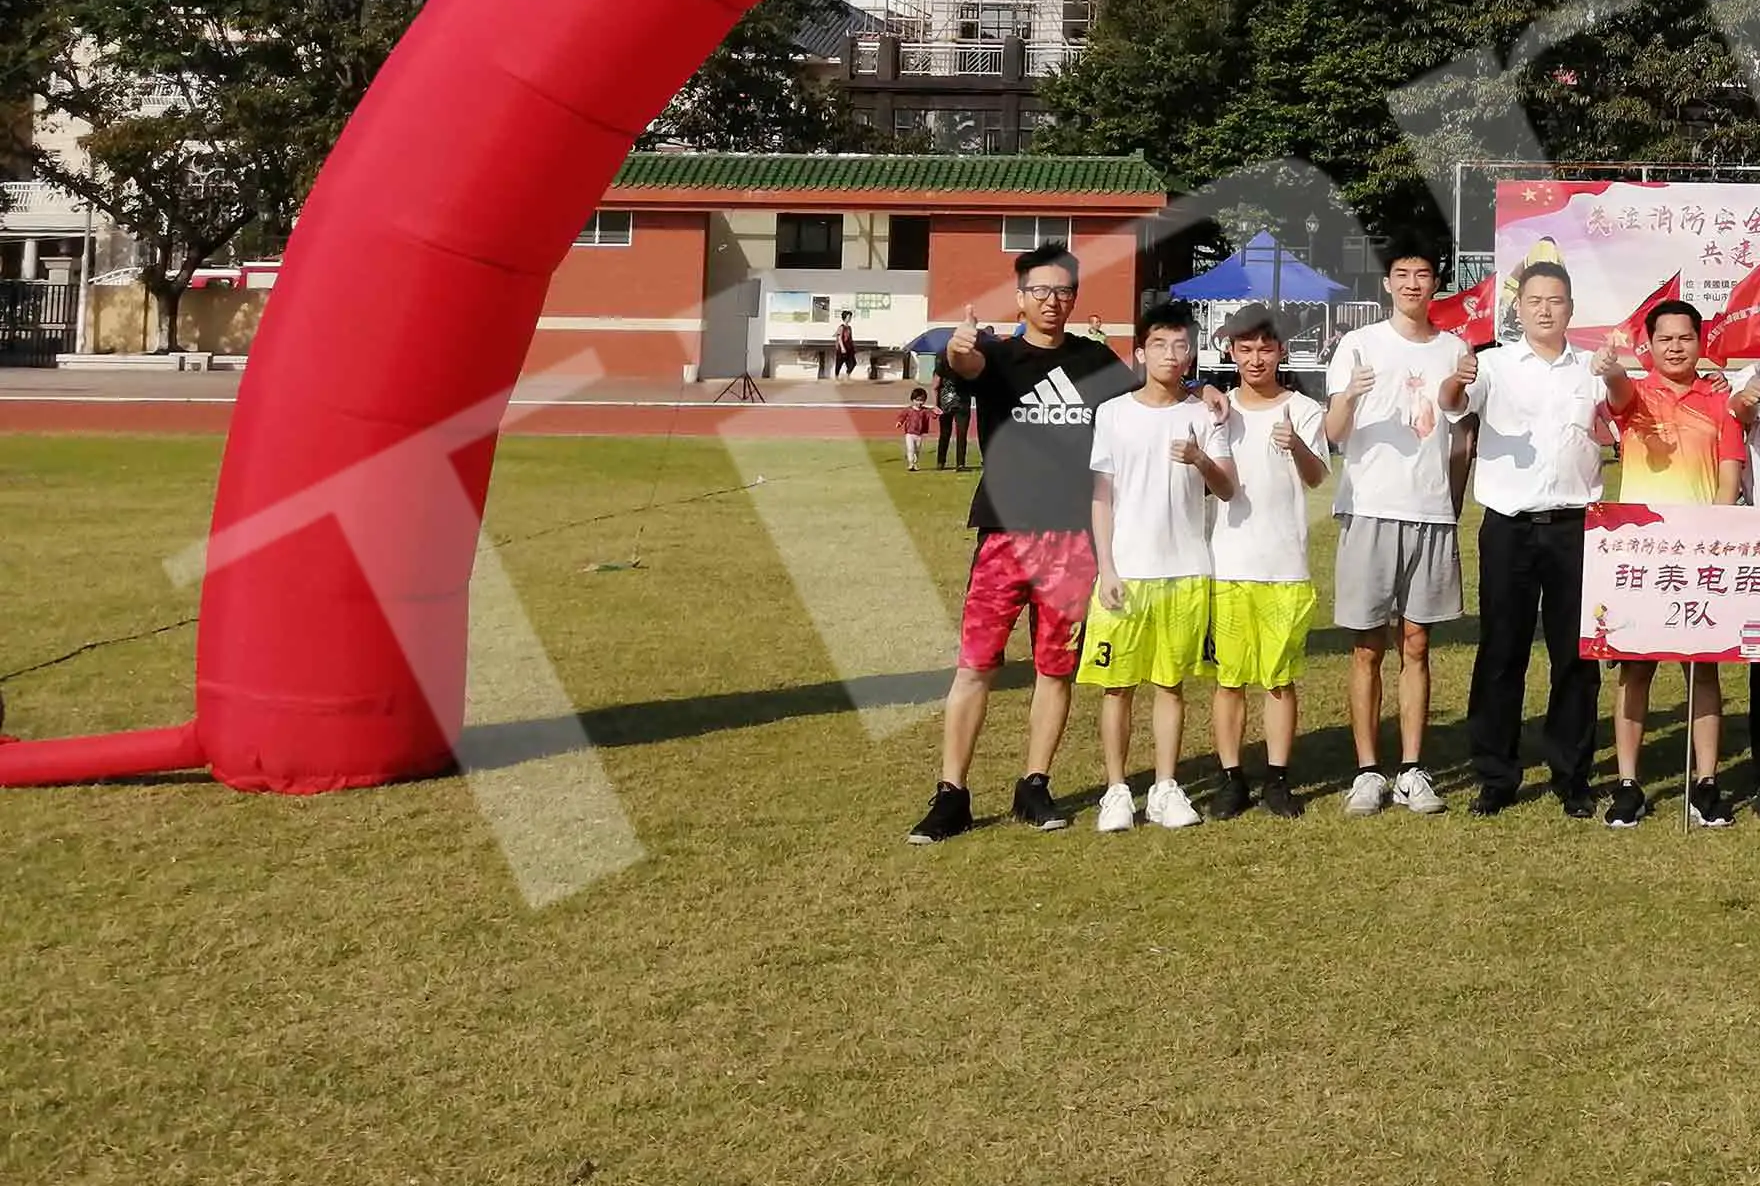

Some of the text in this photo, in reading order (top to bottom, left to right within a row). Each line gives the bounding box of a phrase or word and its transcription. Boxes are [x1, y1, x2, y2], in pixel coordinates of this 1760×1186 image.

[1011, 402, 1093, 425] adidas
[1664, 600, 1717, 627] 2队
[1094, 640, 1113, 668] 3
